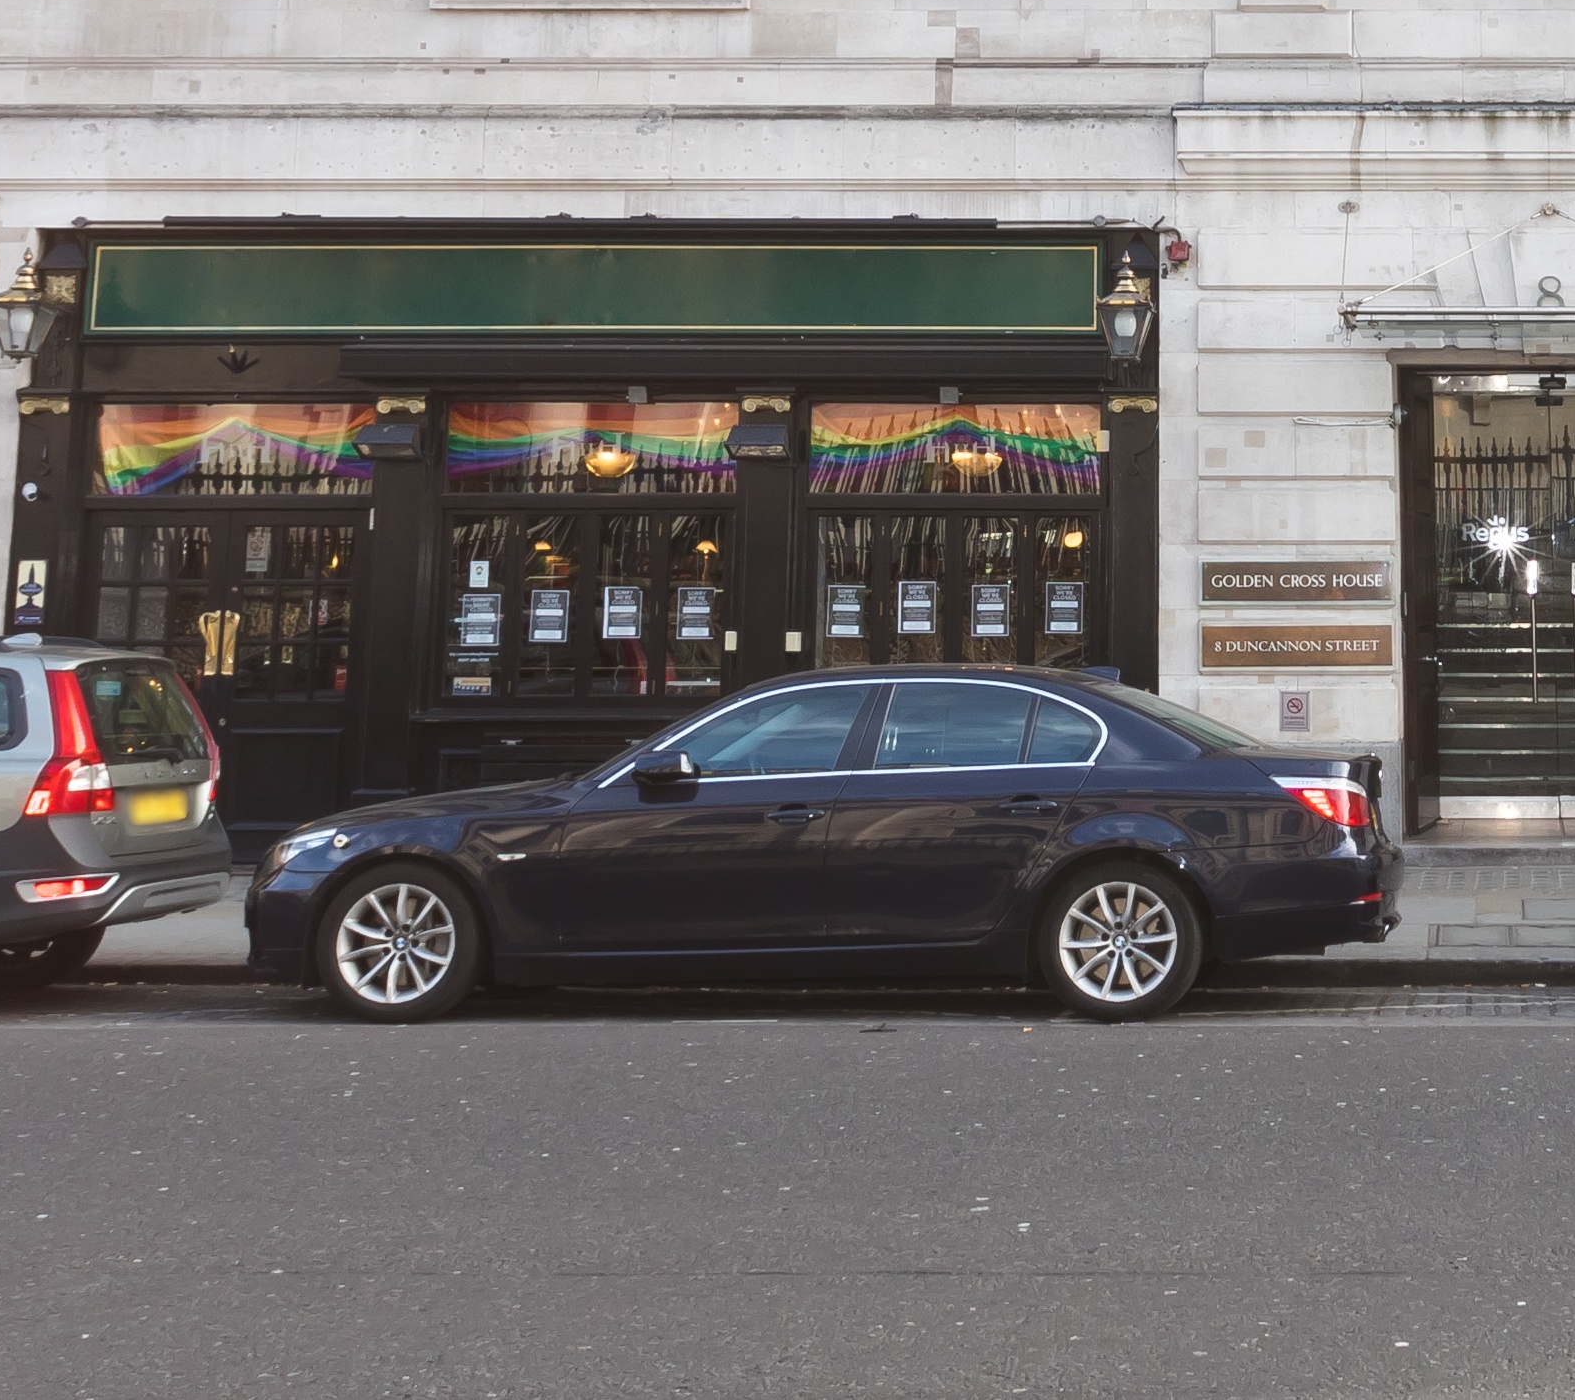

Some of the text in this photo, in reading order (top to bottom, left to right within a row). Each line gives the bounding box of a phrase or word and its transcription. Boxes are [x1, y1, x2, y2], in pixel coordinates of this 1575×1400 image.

[1537, 276, 1565, 307] 8
[1461, 522, 1530, 550] Regus
[1211, 573, 1383, 588] GOLDEN CROSS HOUSE
[1214, 639, 1380, 652] 8 DUNCANNON STREET
